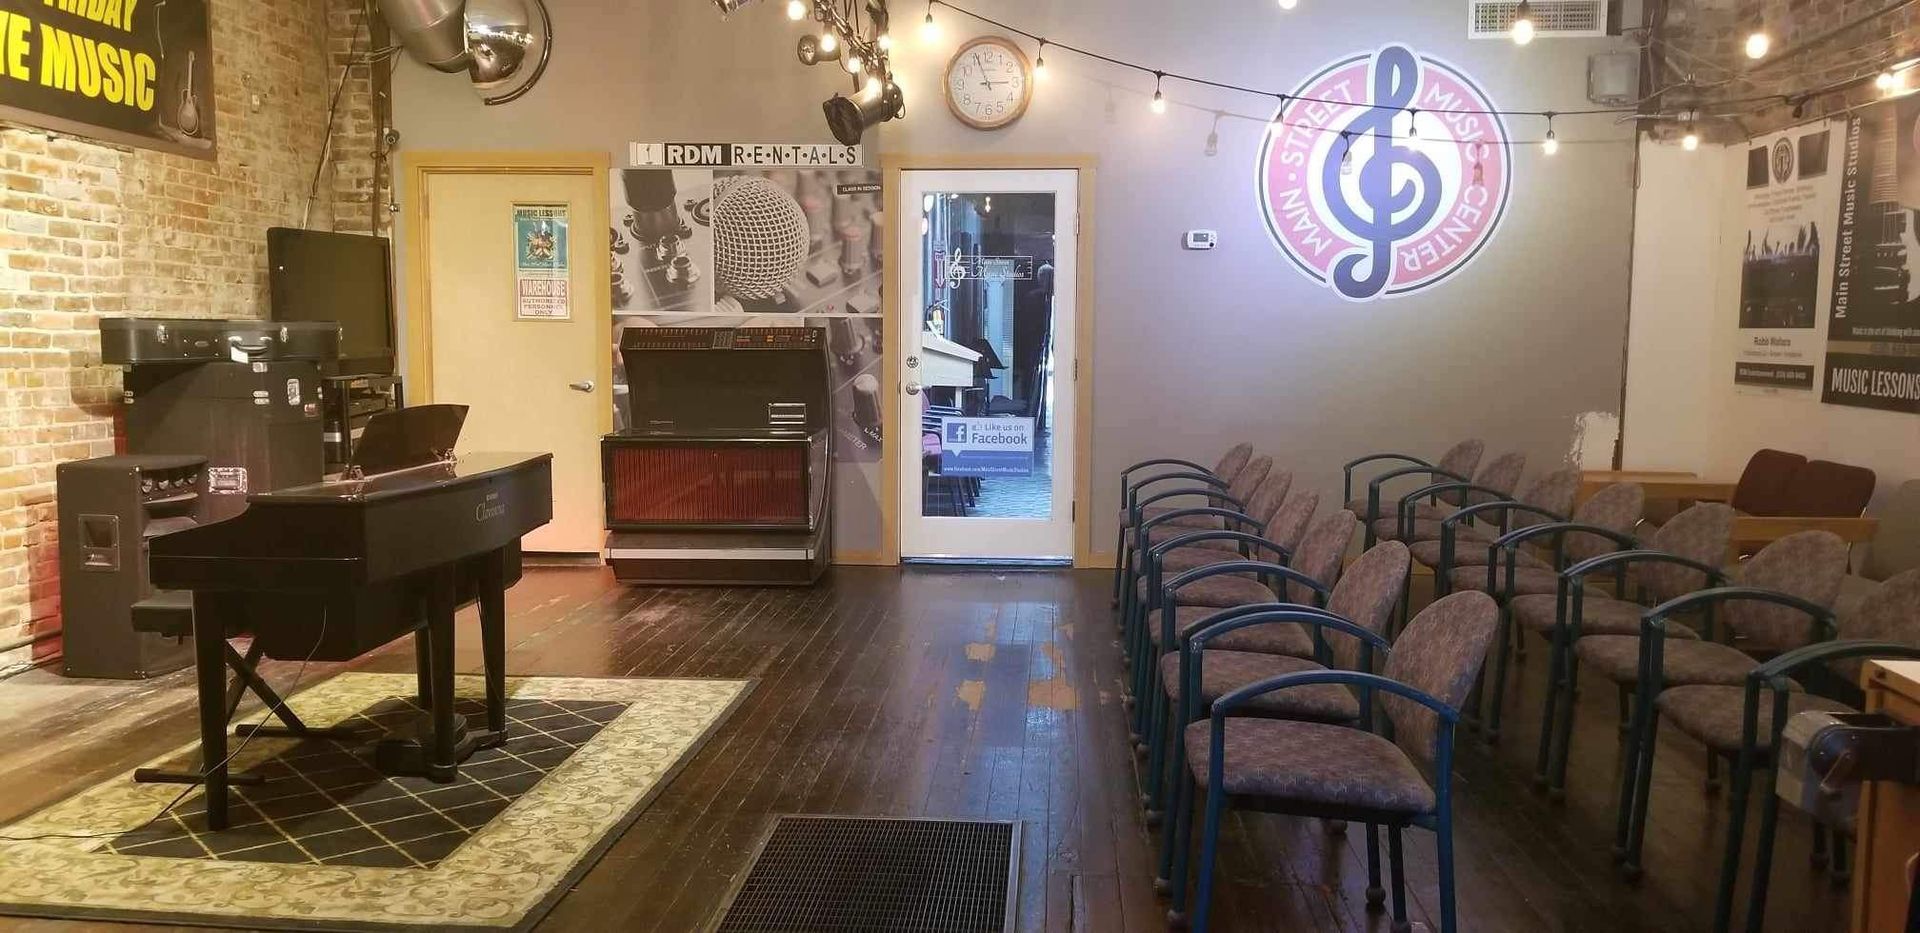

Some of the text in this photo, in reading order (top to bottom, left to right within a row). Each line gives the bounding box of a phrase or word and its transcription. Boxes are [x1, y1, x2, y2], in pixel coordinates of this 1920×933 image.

[43, 0, 137, 32] DAY
[40, 23, 156, 111] MUSIC
[667, 144, 722, 164] RDM
[1280, 80, 1490, 272] MAIN STREET MUSIC CENTER
[1835, 116, 1862, 318] Main Street Music Studios
[522, 280, 566, 297] WAREHOUSE
[1831, 367, 1920, 400] MUSIC LESSONS
[972, 432, 1028, 444] Facebook
[985, 423, 1001, 431] Like
